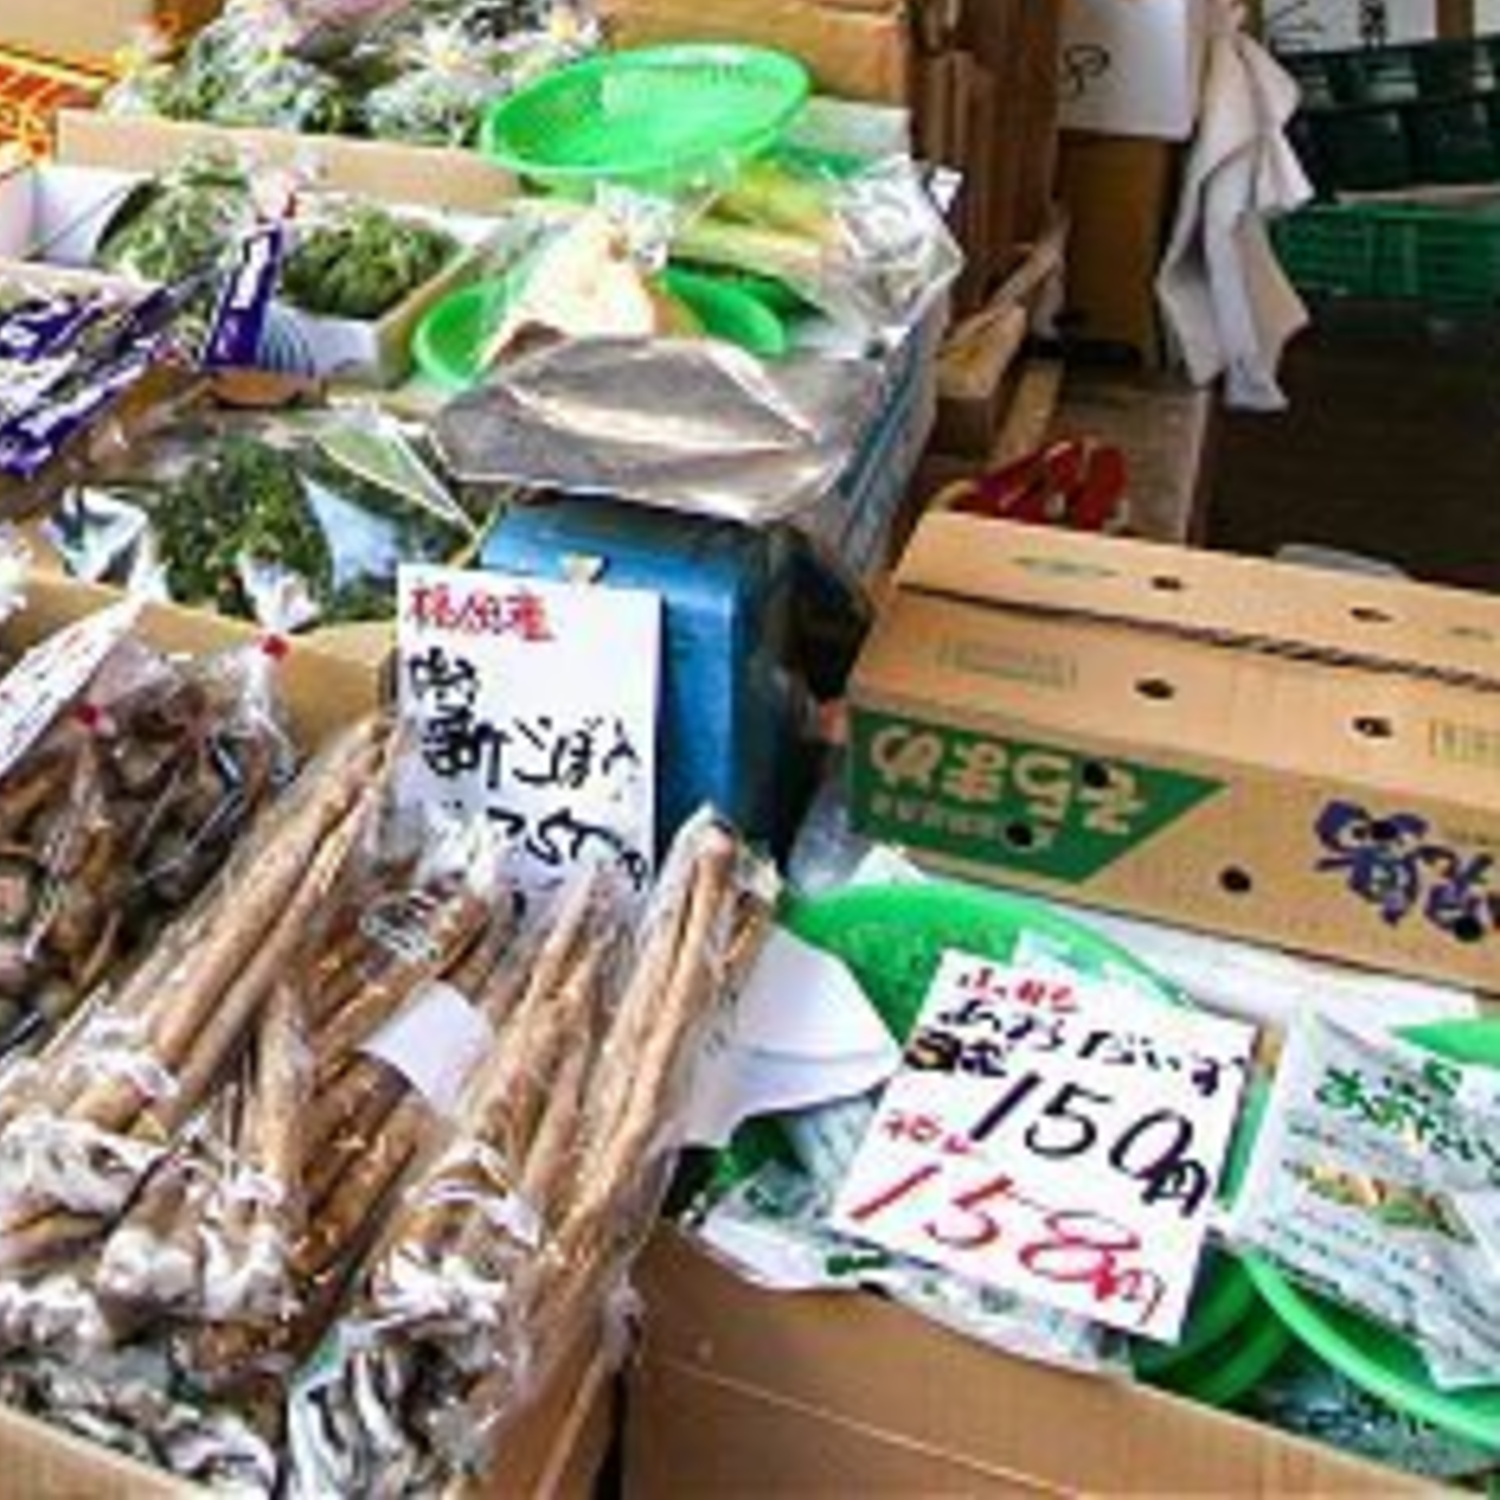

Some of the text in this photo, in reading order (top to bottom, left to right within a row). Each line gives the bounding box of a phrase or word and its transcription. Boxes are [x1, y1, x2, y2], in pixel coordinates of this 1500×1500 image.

[870, 725, 1148, 836] そらまめ
[969, 1070, 1211, 1216] 150円
[850, 1162, 1168, 1327] 158円
